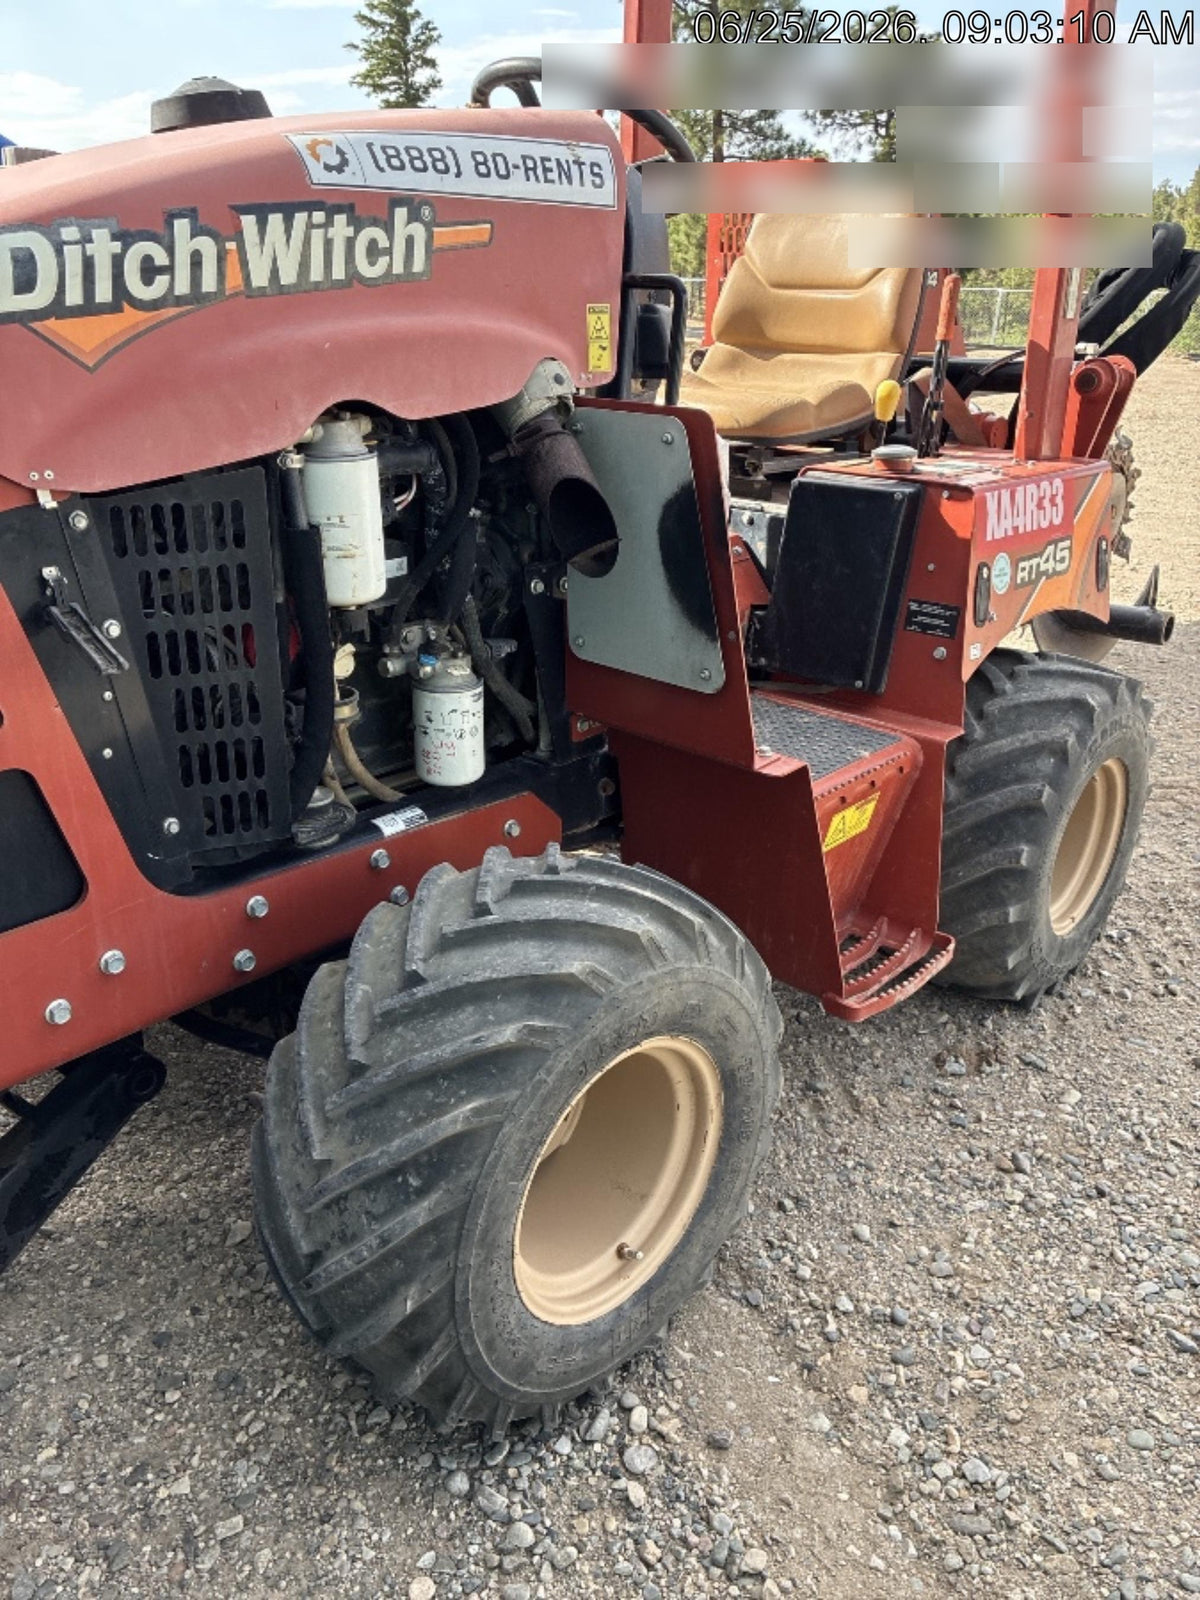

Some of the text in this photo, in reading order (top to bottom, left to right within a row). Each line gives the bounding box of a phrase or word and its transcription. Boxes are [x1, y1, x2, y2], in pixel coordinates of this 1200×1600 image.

[366, 142, 605, 189] (888) 80-RENTS
[0, 217, 218, 313] Ditch
[985, 478, 1064, 541] XA4R33
[1017, 540, 1071, 583] RT45
